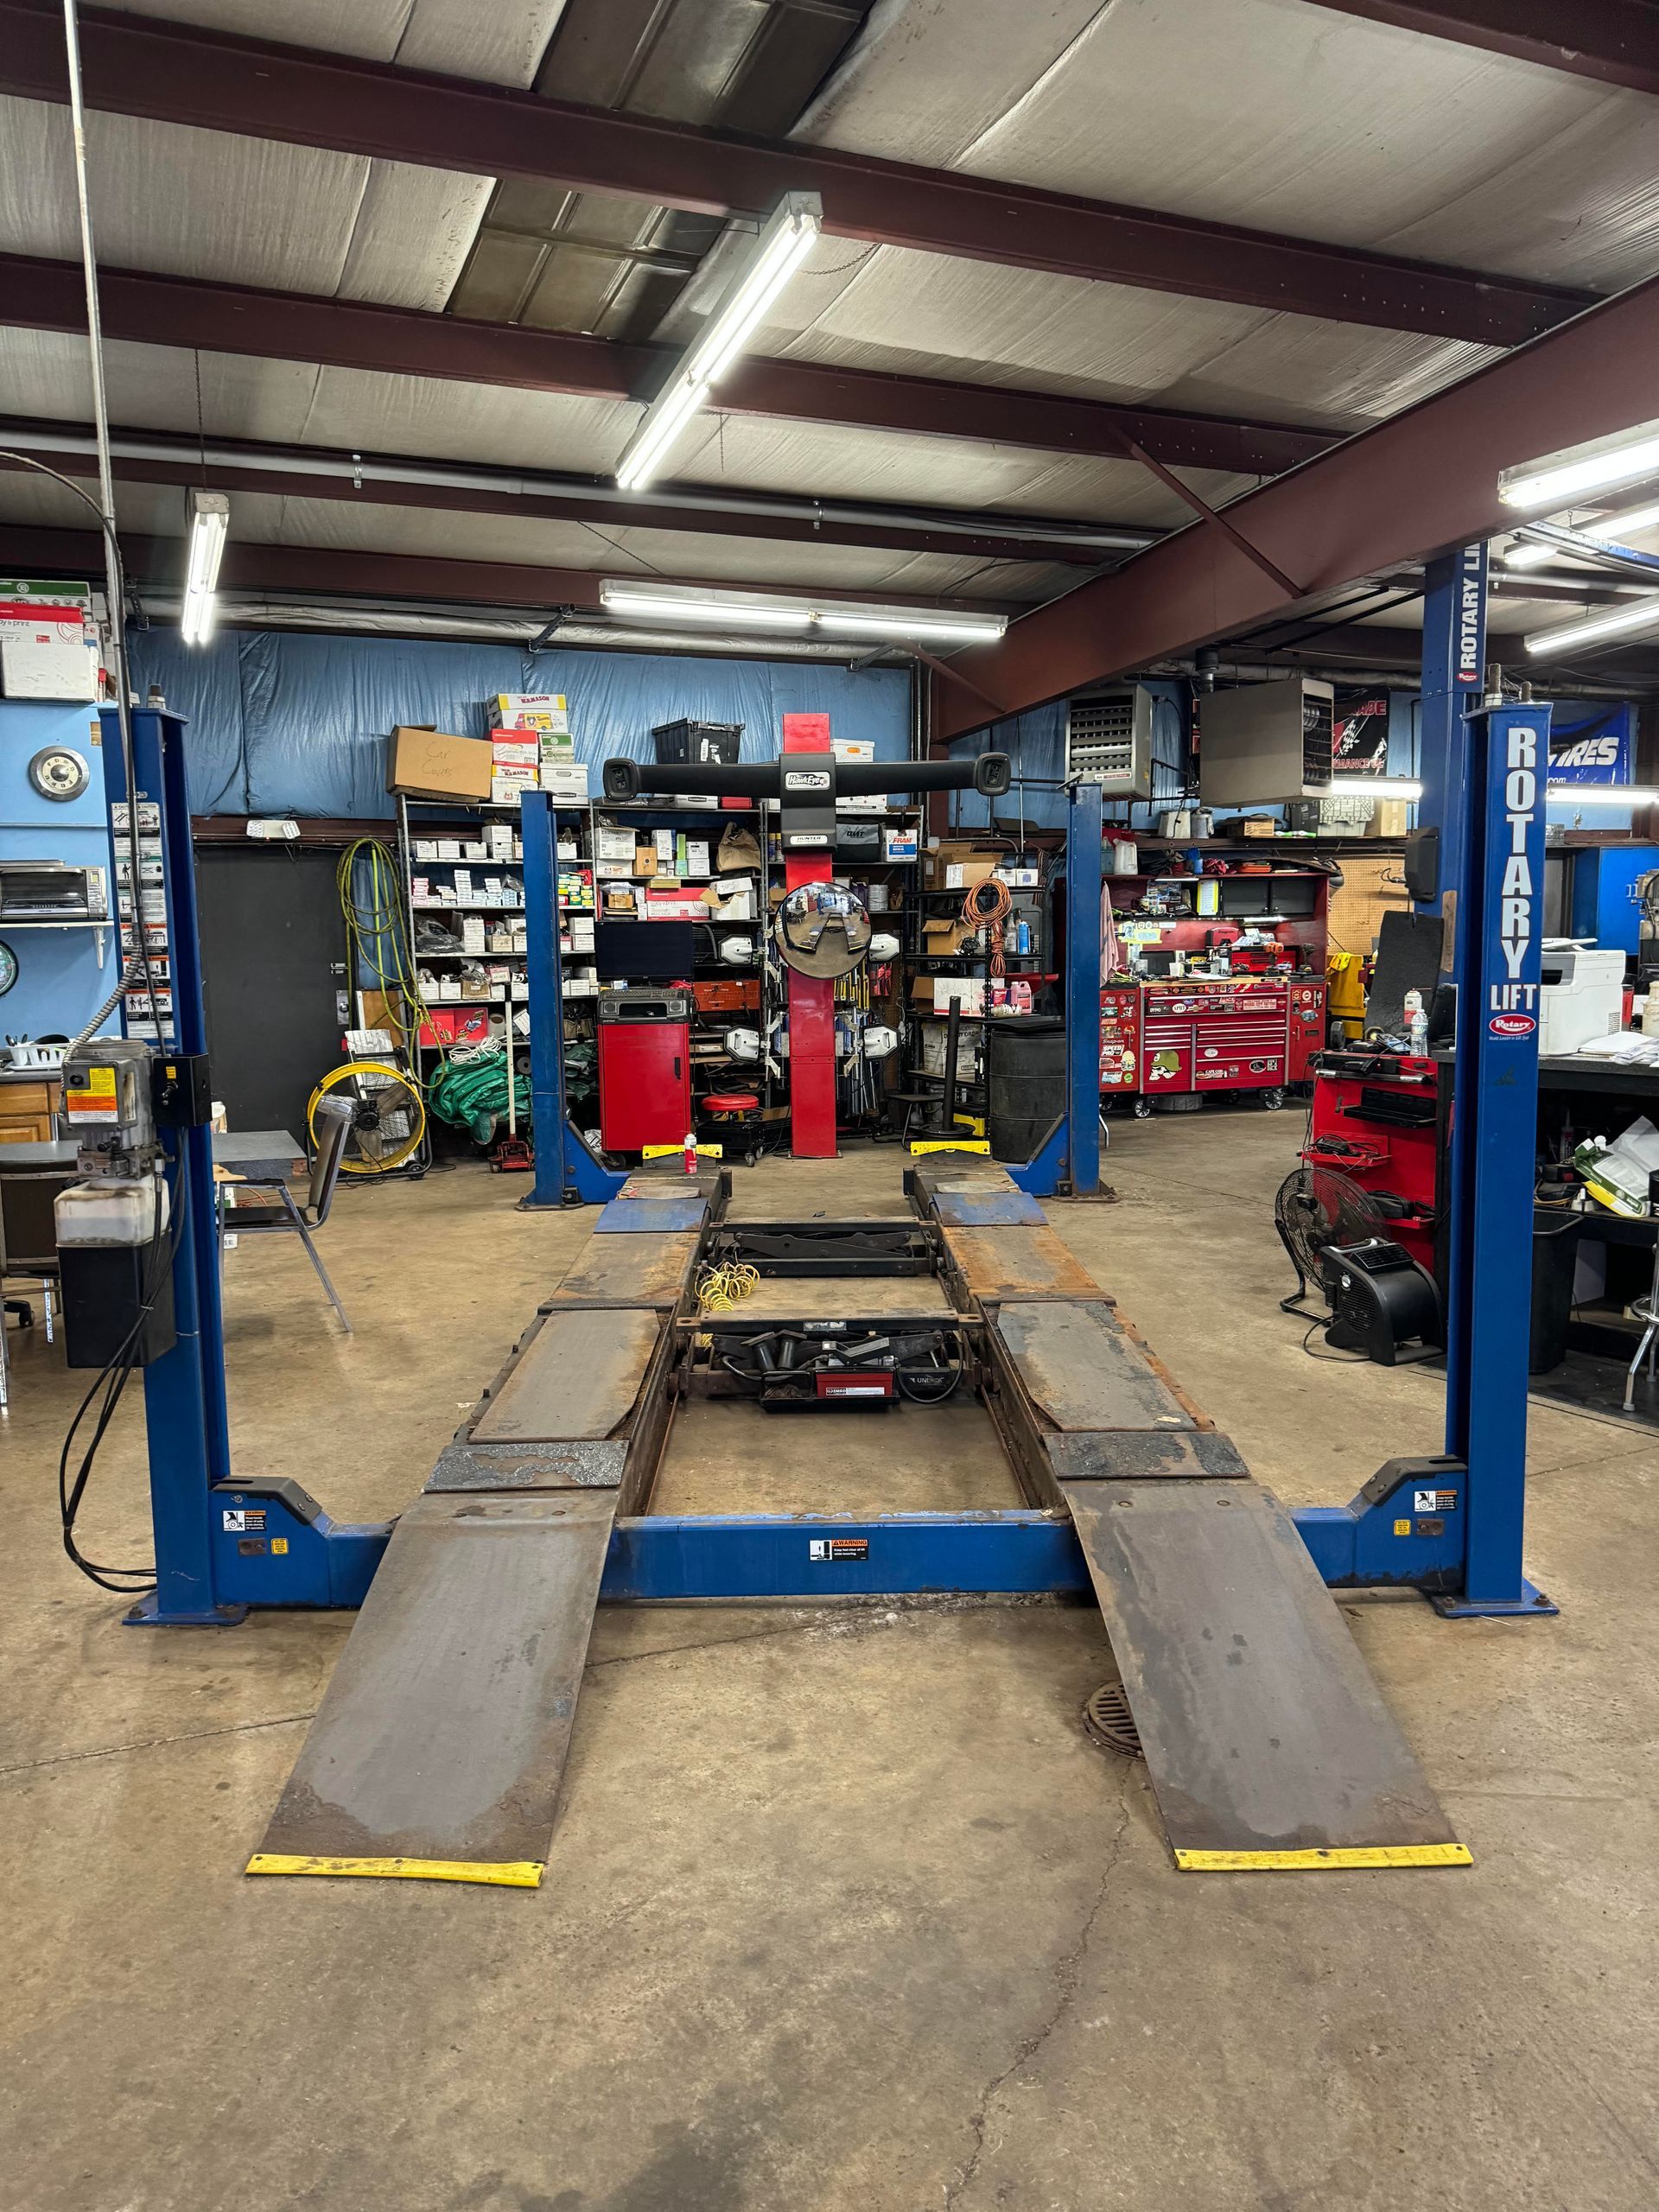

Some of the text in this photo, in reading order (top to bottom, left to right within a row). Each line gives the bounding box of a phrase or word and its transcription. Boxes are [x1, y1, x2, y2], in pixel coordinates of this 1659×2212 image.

[1460, 577, 1479, 669] ROTARY
[788, 774, 820, 785] HawkEye
[1502, 728, 1536, 979] ROTARY
[1491, 984, 1537, 1010] LIFT
[1495, 1020, 1531, 1032] Rotary
